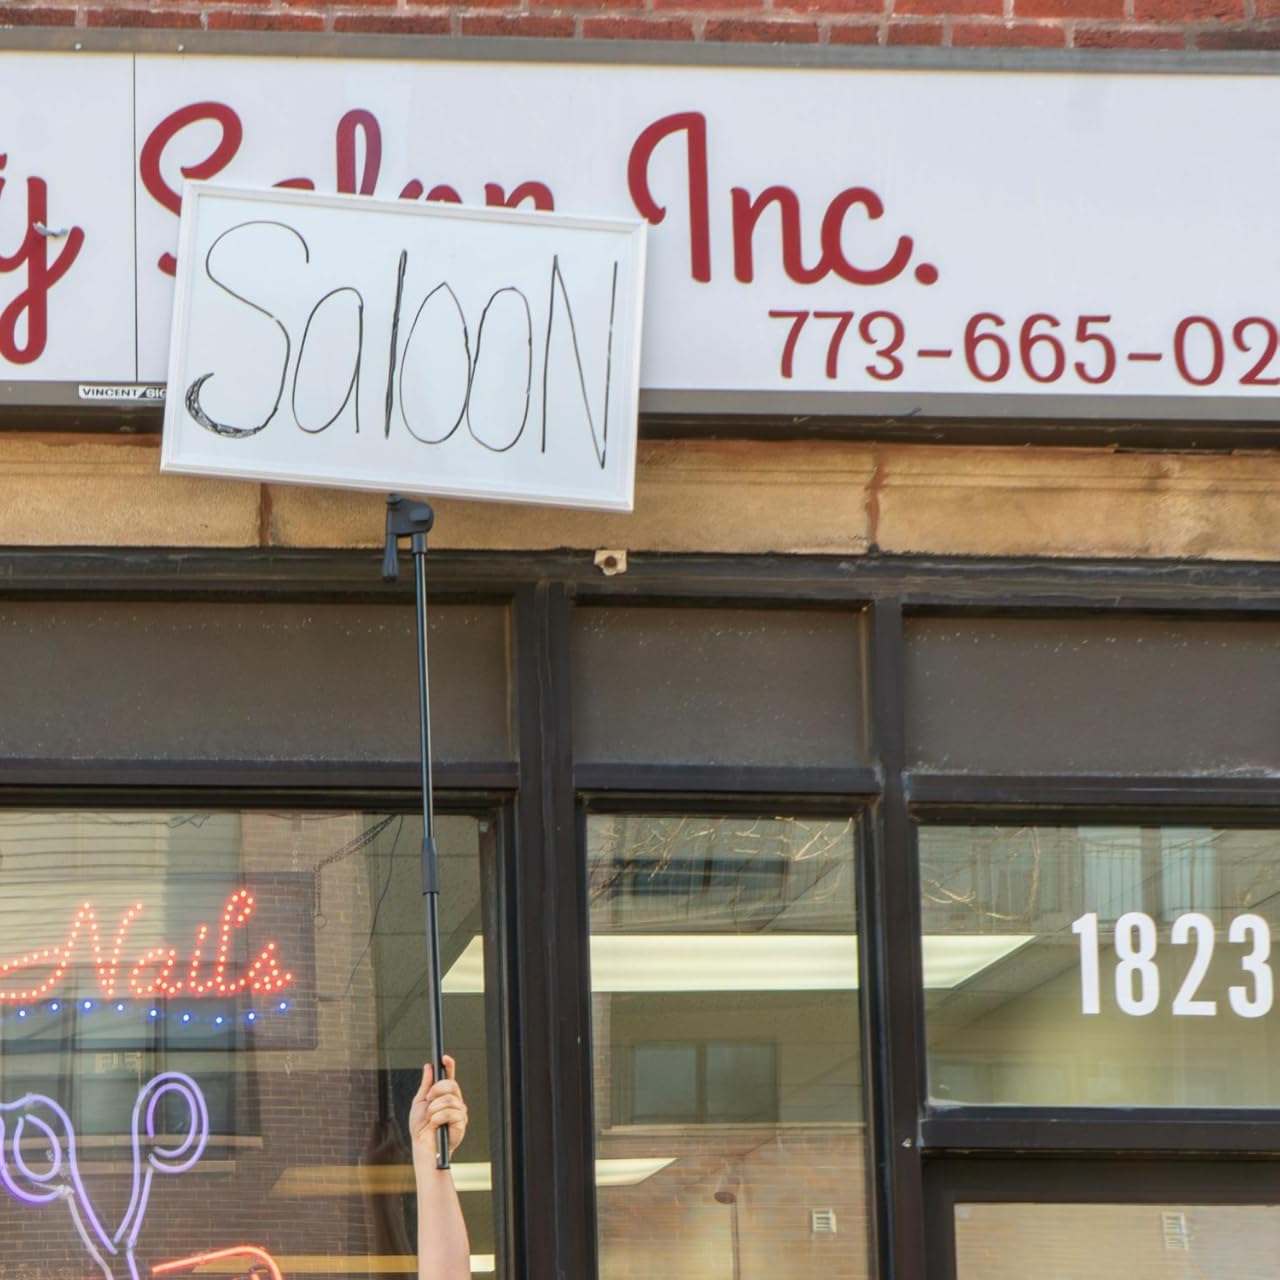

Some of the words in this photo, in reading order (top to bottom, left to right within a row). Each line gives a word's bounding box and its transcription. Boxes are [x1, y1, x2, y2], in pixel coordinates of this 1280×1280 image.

[627, 111, 939, 286] Inc.
[82, 387, 138, 397] VINCENT
[1072, 911, 1274, 1018] 1823
